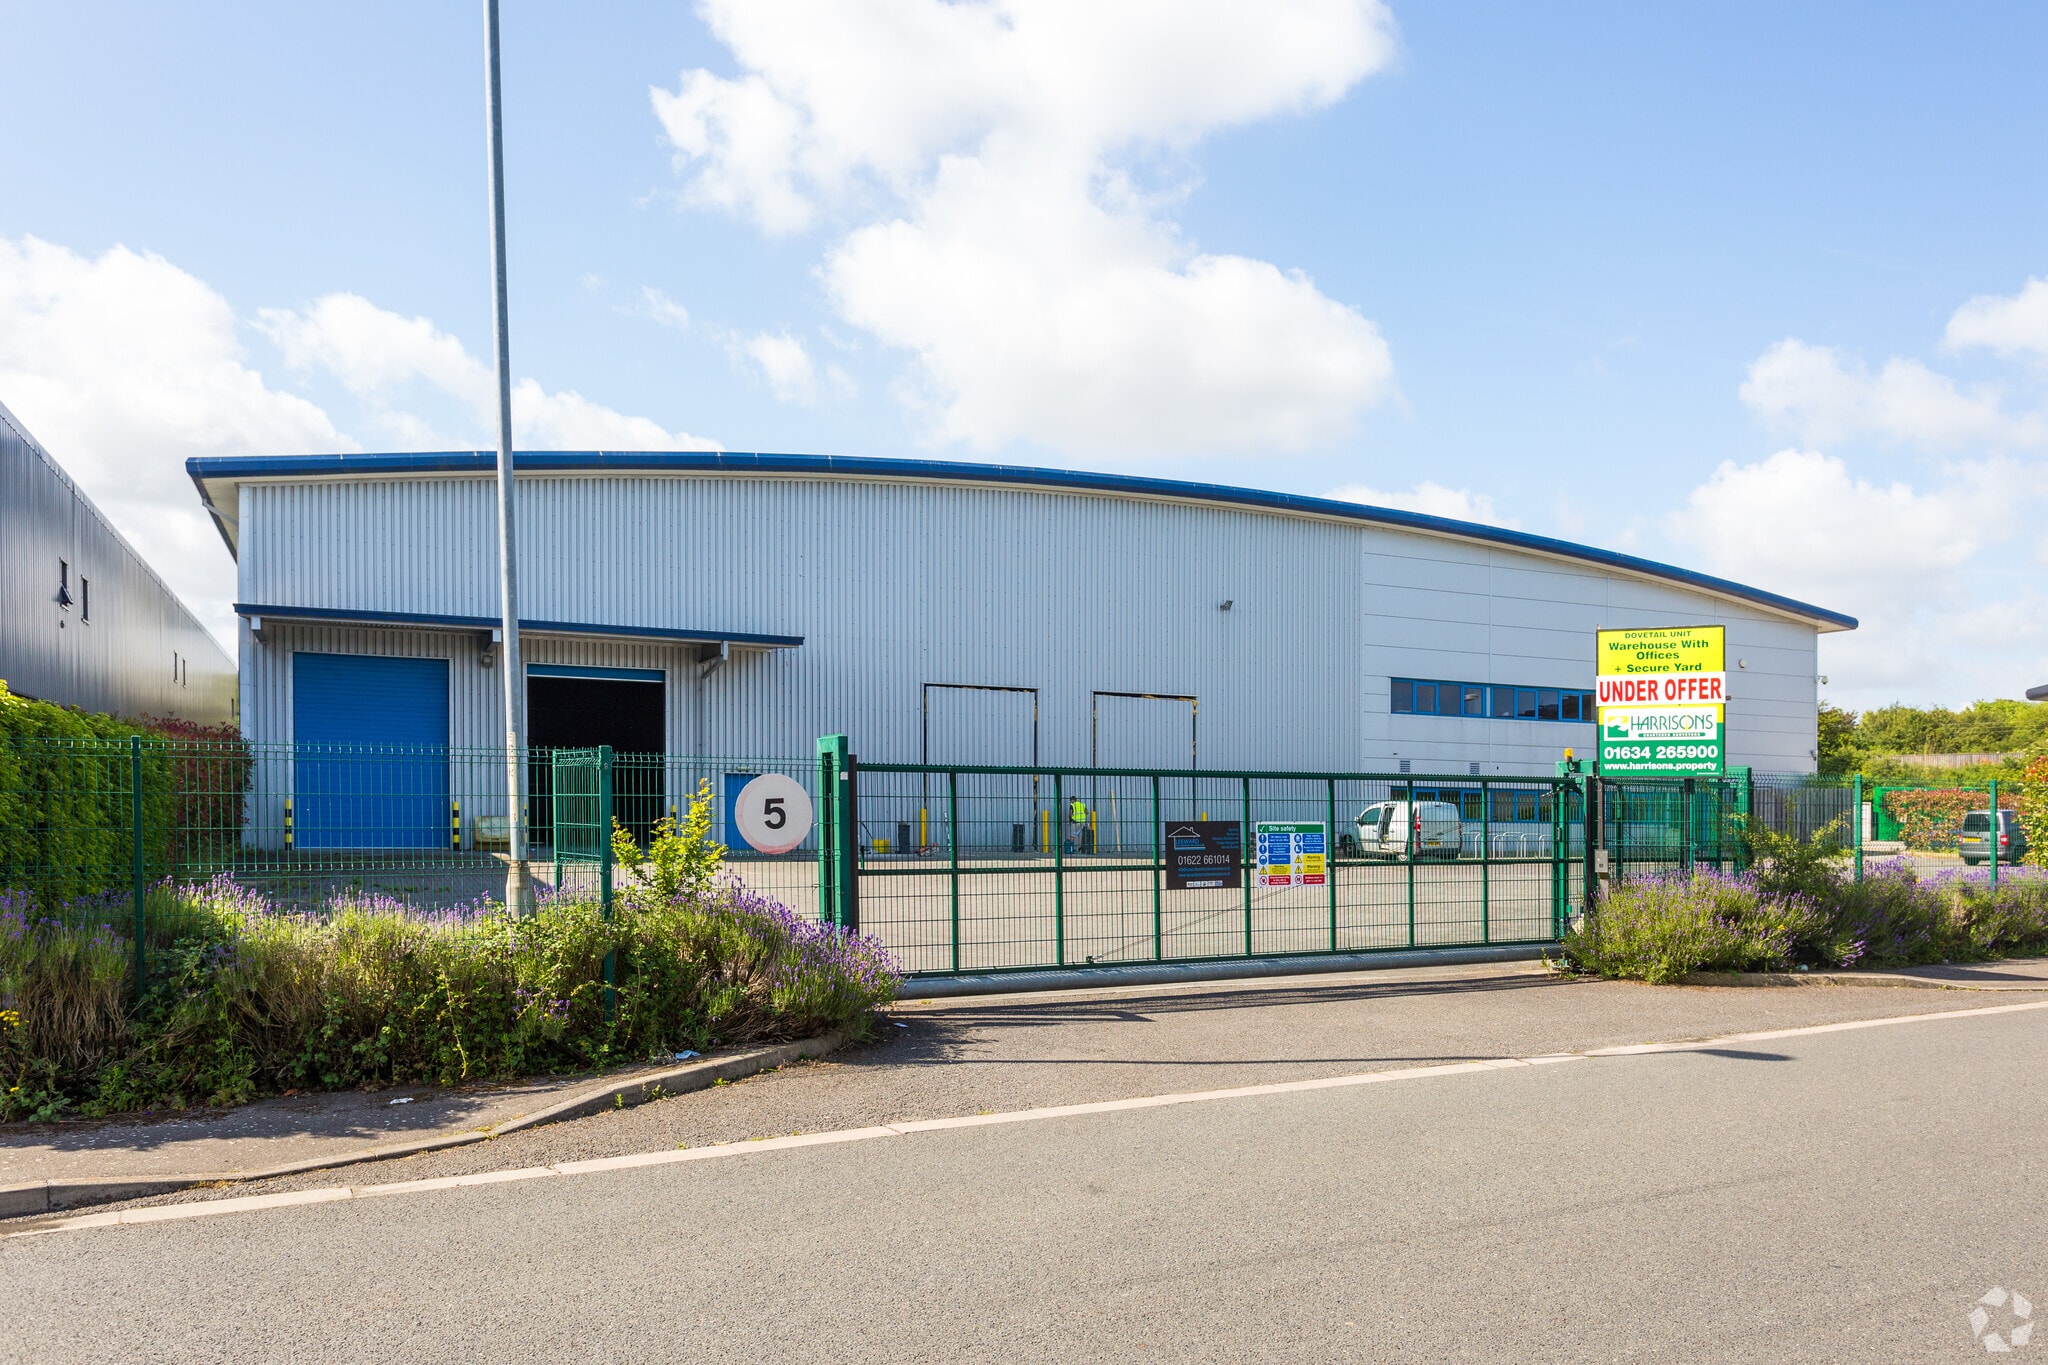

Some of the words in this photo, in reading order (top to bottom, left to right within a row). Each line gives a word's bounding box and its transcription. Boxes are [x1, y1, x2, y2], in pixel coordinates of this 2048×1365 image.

[1609, 641, 1677, 651] Warehouse
[1681, 640, 1709, 649] With
[1636, 651, 1680, 660] Offices
[1626, 664, 1670, 672] Secure
[1674, 663, 1702, 671] Yard
[1600, 680, 1659, 702] UNDER
[1664, 678, 1722, 700] OFFER
[1630, 714, 1713, 730] HARRISONS
[1604, 746, 1651, 759] 01634
[1656, 745, 1718, 759] 265900
[1604, 761, 1717, 771] www.harrisons.property
[764, 798, 786, 829] 5
[1177, 855, 1202, 866] 01622
[1203, 854, 1230, 865] 661014
